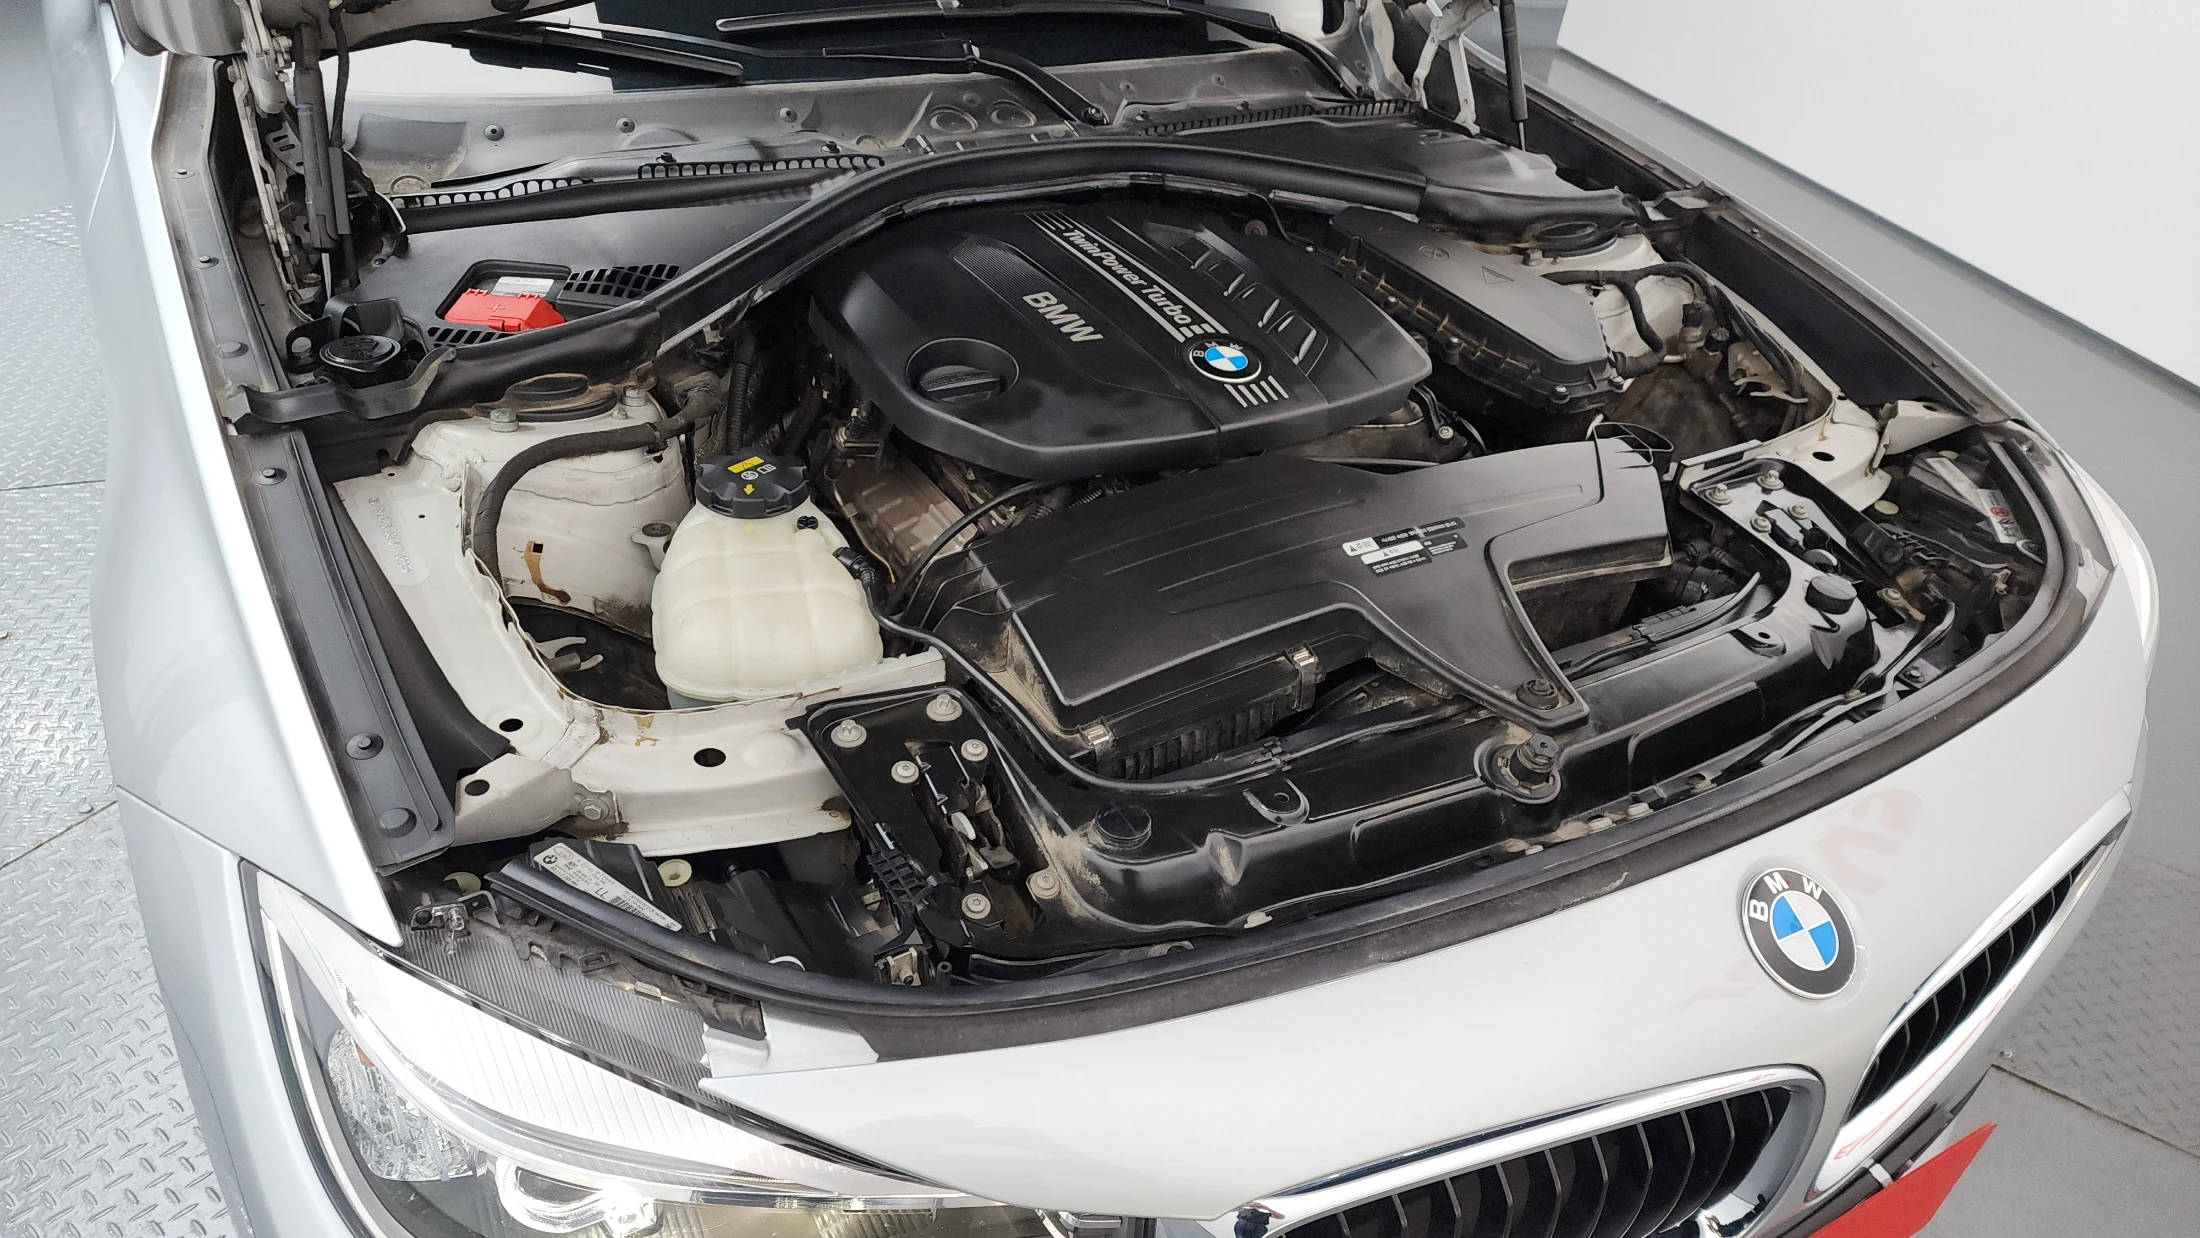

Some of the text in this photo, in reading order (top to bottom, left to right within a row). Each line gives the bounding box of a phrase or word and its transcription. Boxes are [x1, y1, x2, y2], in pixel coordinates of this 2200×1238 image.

[1062, 229, 1192, 324] TwinPower Turbo
[1022, 291, 1103, 342] BMW
[1193, 340, 1243, 358] BMW
[1749, 871, 1823, 922] BMW
